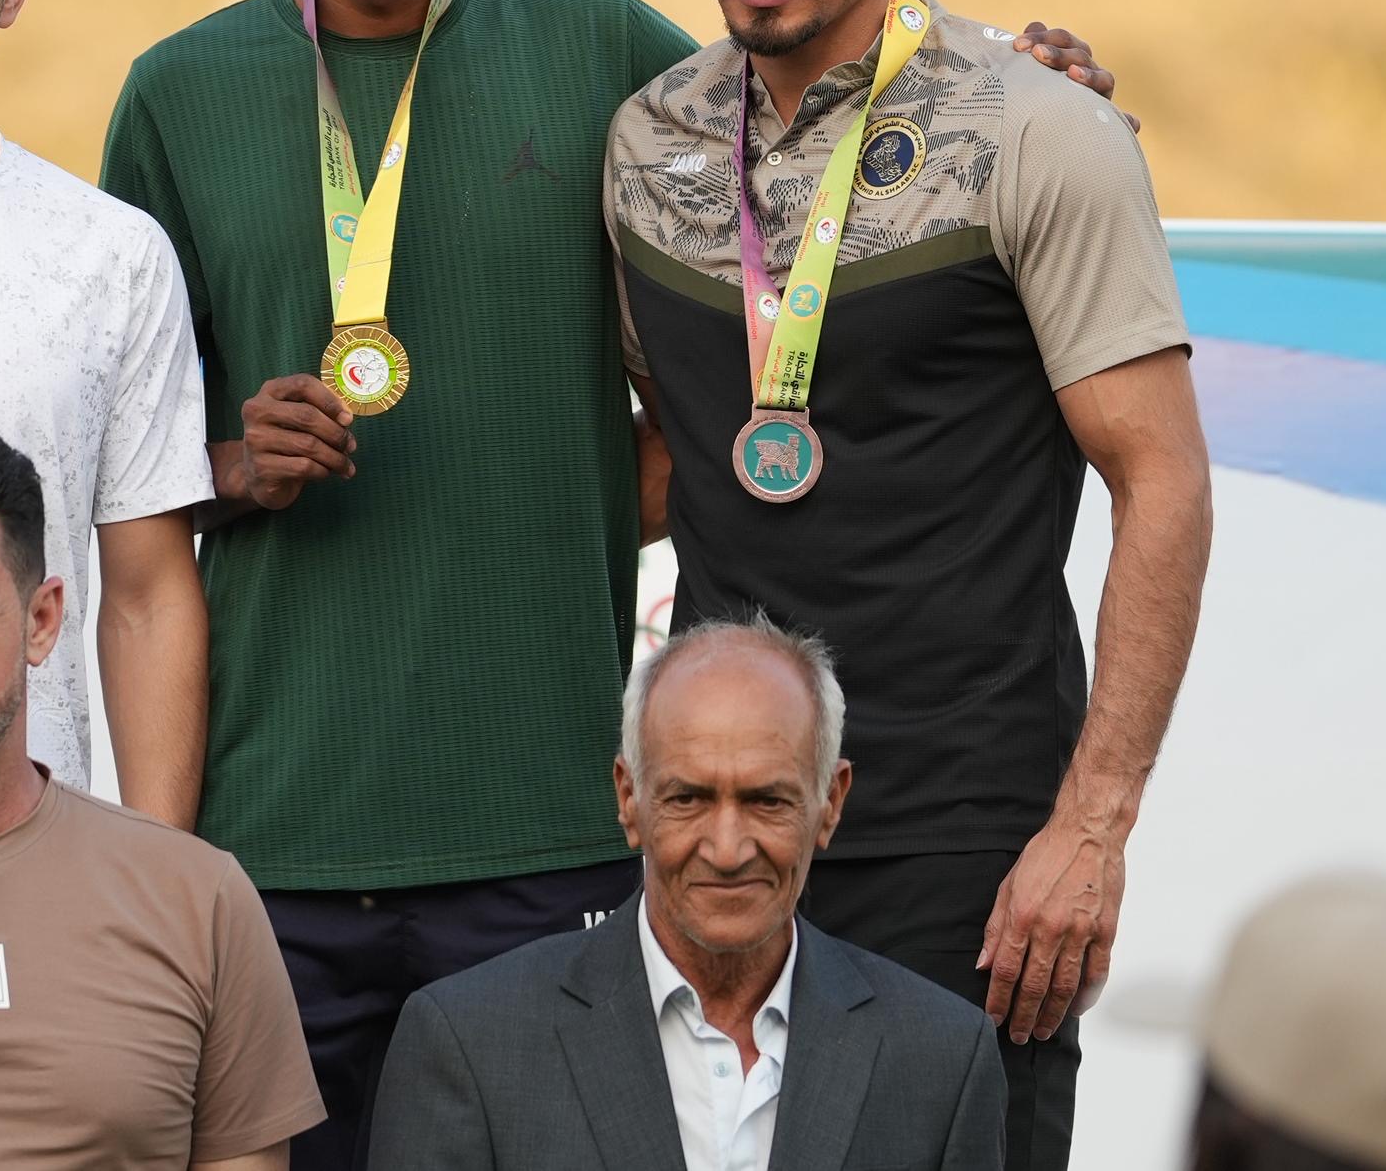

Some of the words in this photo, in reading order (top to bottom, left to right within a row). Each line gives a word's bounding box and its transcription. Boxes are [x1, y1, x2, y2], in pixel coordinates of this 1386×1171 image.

[337, 169, 345, 190] TRADE
[797, 222, 814, 262] Federation
[749, 299, 758, 340] Federation
[783, 349, 796, 379] TRADE
[777, 381, 789, 406] BANK
